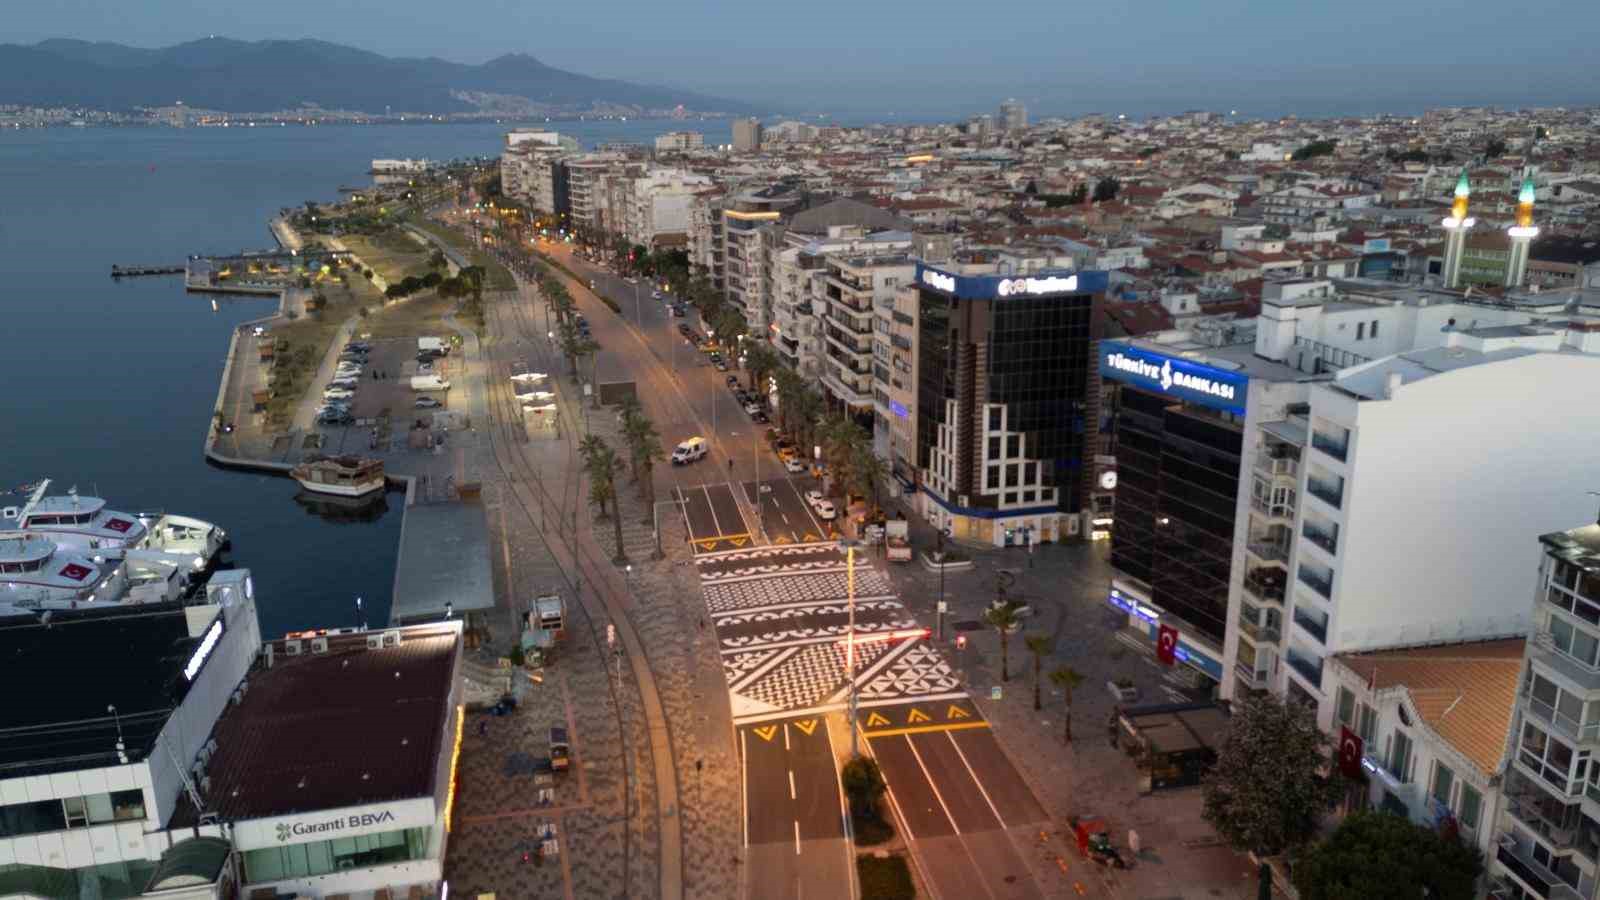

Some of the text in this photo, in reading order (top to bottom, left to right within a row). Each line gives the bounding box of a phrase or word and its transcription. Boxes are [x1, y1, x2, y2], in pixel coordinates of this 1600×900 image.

[1107, 353, 1160, 379] TÜRKİYE
[1172, 371, 1235, 399] BANKASI
[292, 810, 395, 836] Garanti BBVA
